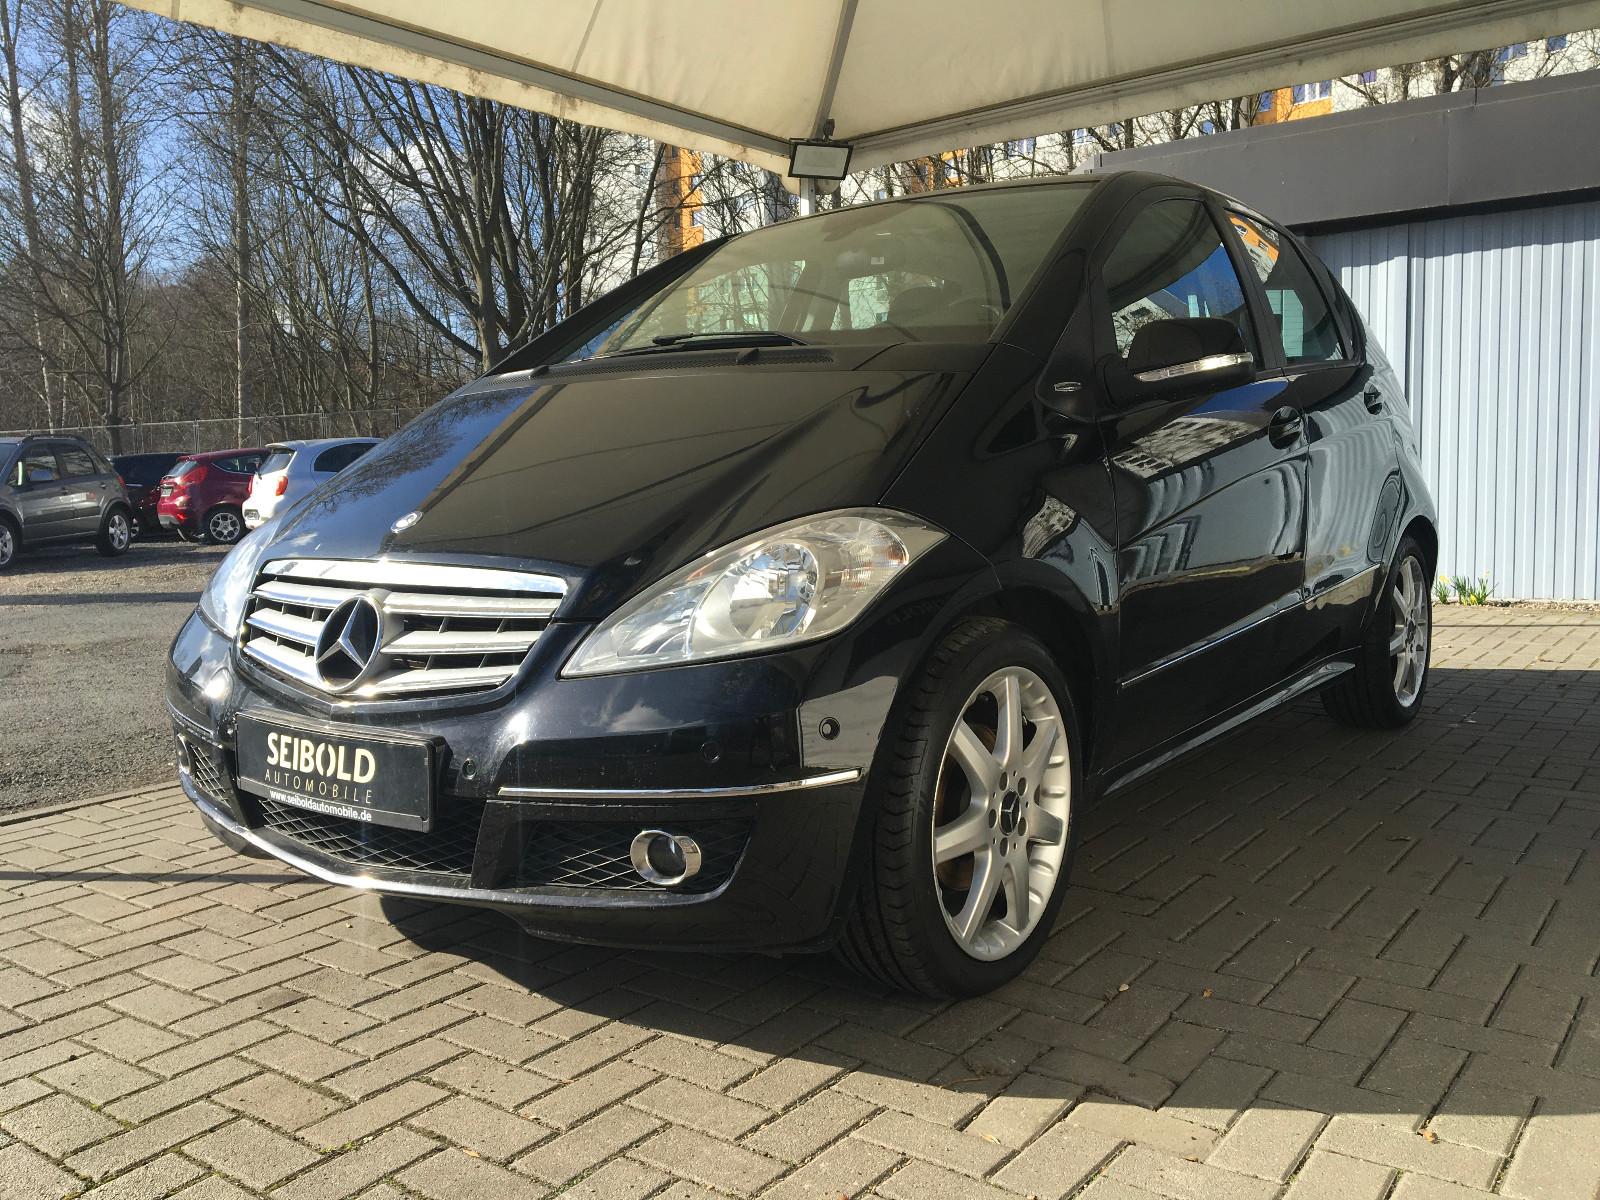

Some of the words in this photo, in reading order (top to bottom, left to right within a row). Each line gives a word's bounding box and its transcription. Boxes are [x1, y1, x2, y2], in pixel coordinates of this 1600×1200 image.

[267, 732, 376, 783] SEIBOLD
[265, 769, 372, 804] AUTOMOBILE
[269, 790, 372, 822] www.seiboldautomobile.de
